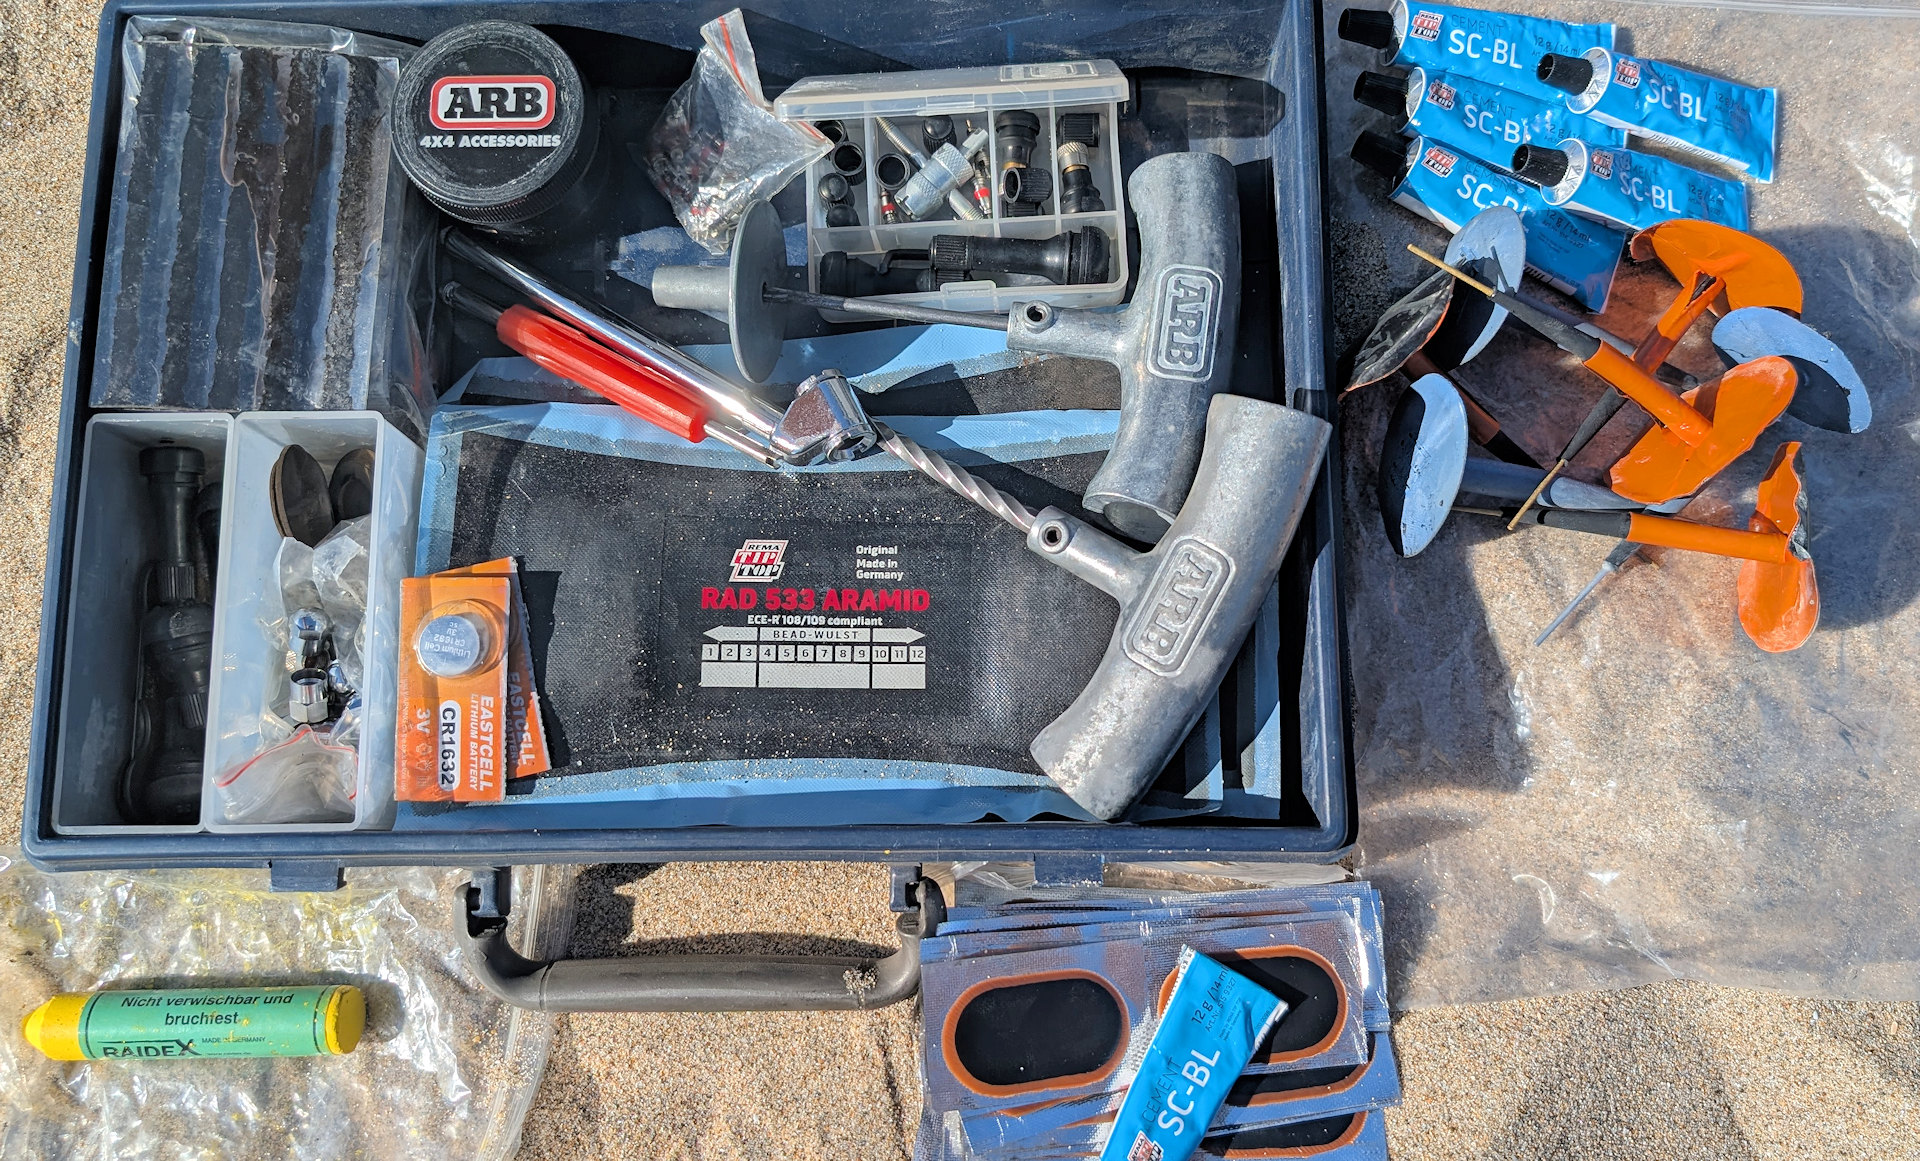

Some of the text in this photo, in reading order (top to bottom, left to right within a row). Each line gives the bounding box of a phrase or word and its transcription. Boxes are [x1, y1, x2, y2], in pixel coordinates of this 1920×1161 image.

[1413, 17, 1438, 29] TIP
[1415, 26, 1439, 39] TOP
[1451, 14, 1504, 35] CEMENT
[1448, 30, 1523, 69] SC-BL
[1619, 73, 1640, 87] TOP
[444, 86, 543, 119] ARB
[1464, 90, 1516, 118] CEMENT
[1645, 79, 1707, 122] SC-BL
[420, 134, 561, 148] 4X4 ACCESSORIES
[1593, 164, 1611, 178] TOP
[1620, 172, 1681, 214] SC-BL
[1166, 276, 1206, 366] ARB
[736, 552, 777, 565] TIP
[856, 545, 898, 556] Original
[739, 564, 780, 576] TOP
[856, 559, 898, 569] Made in
[856, 570, 904, 581] Germany
[701, 587, 931, 612] RAD 533 ARAMID
[1140, 551, 1213, 656] ARB
[747, 615, 883, 627] ECE-R 108/109 compliant
[773, 630, 859, 640] BEAD-WULST
[425, 642, 470, 659] Lithium Cell
[708, 648, 924, 658] 1 2 3 4 5 6 7 8 9 10 11 12
[416, 708, 431, 734] 3V
[508, 672, 535, 765] EASTCELL
[440, 707, 457, 785] CR1632
[468, 694, 479, 791] LITHIUM BATTERY
[479, 695, 494, 792] EASTCELL
[121, 993, 293, 1009] Nicht verwischbar und
[165, 1011, 239, 1026] bruchfest
[1192, 1009, 1206, 1024] 12
[1202, 1000, 1213, 1012] g
[103, 1039, 202, 1057] RAIDEX
[1142, 1056, 1182, 1123] CEMENT
[1157, 1050, 1221, 1136] SC-BL
